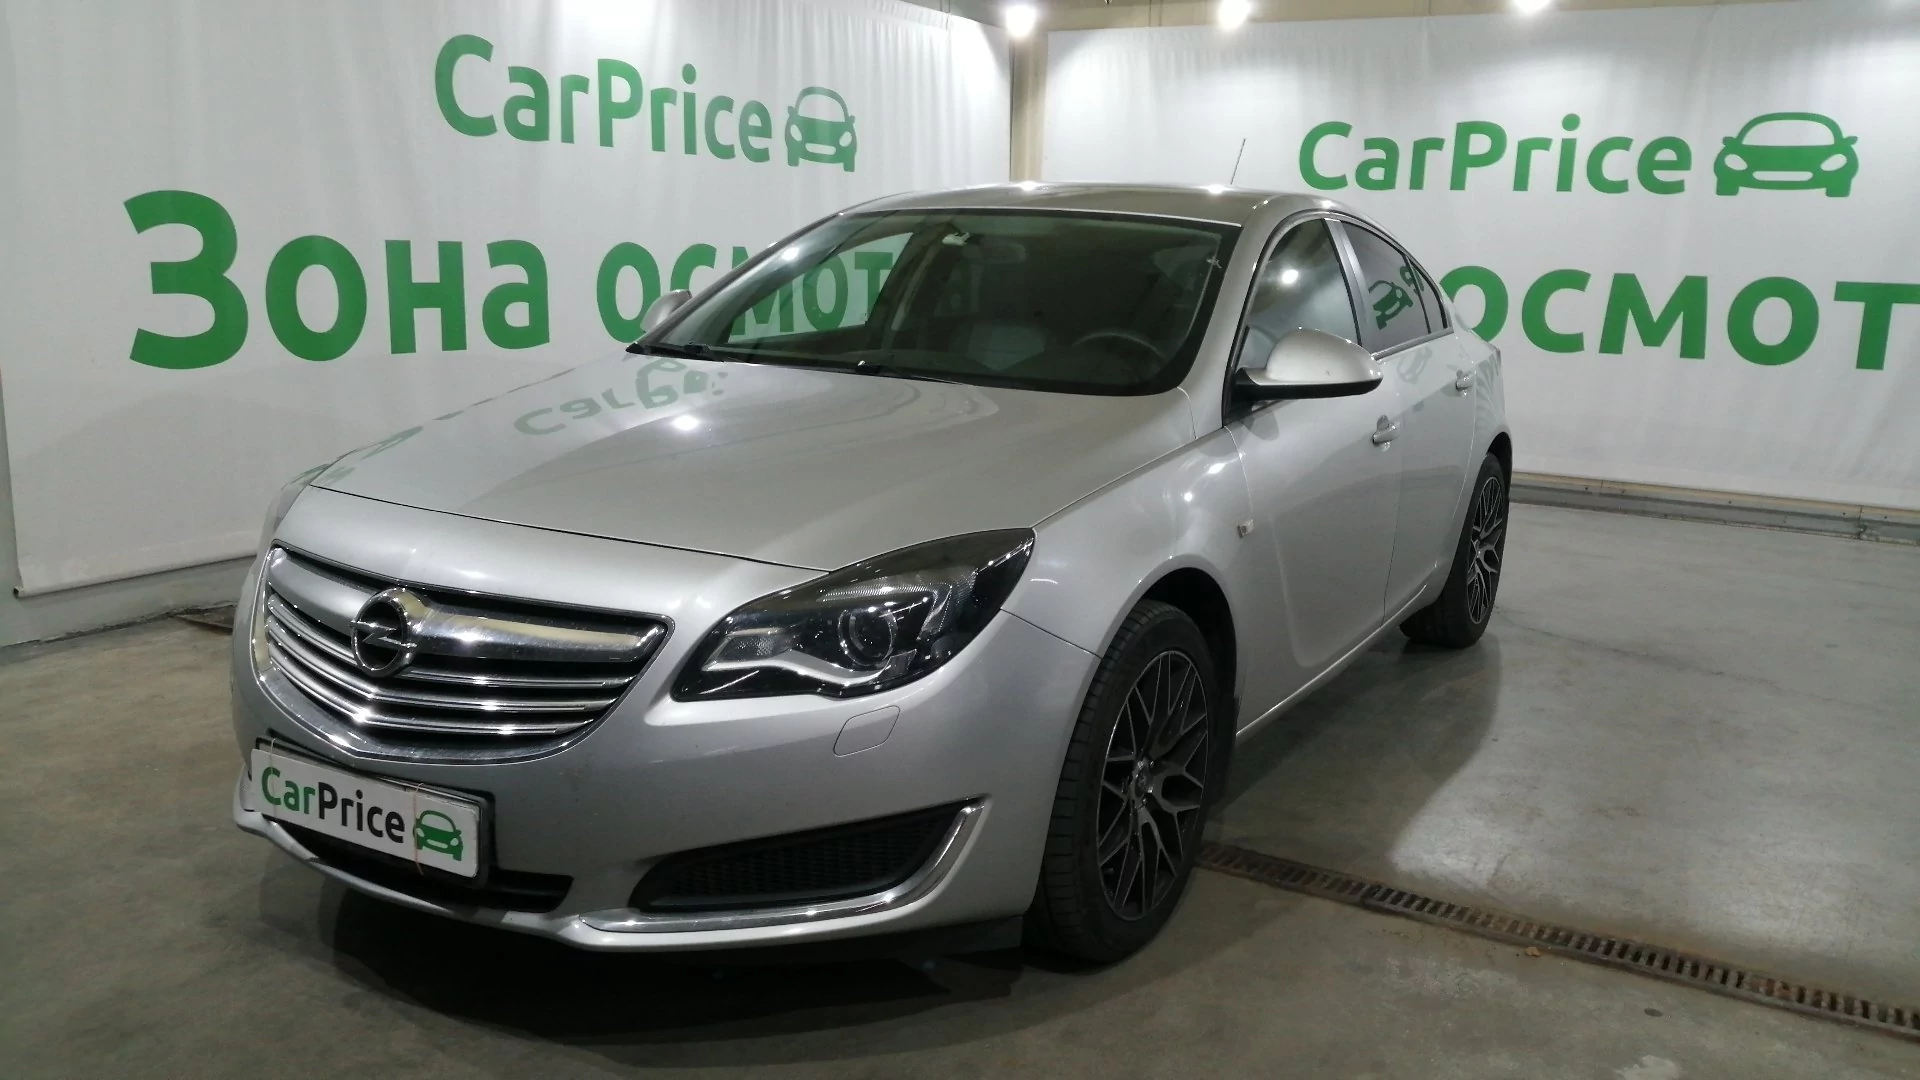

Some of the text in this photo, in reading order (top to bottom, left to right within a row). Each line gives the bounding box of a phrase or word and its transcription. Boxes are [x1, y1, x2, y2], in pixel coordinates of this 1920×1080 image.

[435, 34, 771, 163] CarPrice
[1299, 113, 1692, 195] CarPrice
[124, 190, 550, 370] Зона
[261, 766, 405, 844] CarPrice
